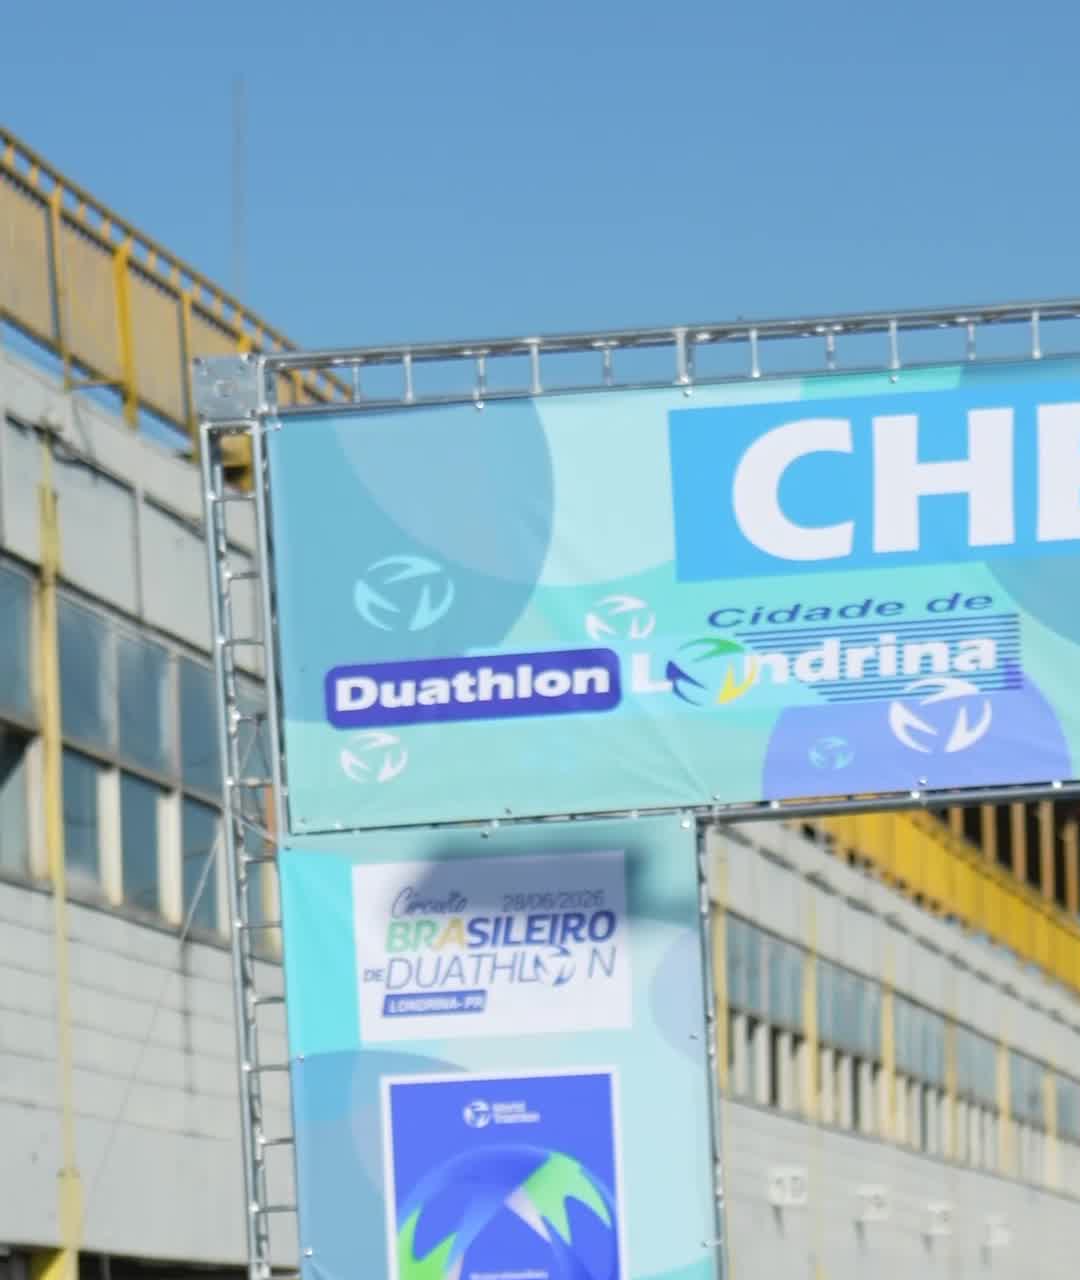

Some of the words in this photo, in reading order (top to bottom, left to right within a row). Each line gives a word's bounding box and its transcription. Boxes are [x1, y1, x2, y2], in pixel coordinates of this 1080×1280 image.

[707, 599, 904, 628] Cidade
[926, 592, 993, 614] de
[335, 664, 609, 711] Duathlon
[385, 909, 617, 952] BRASILEIRO
